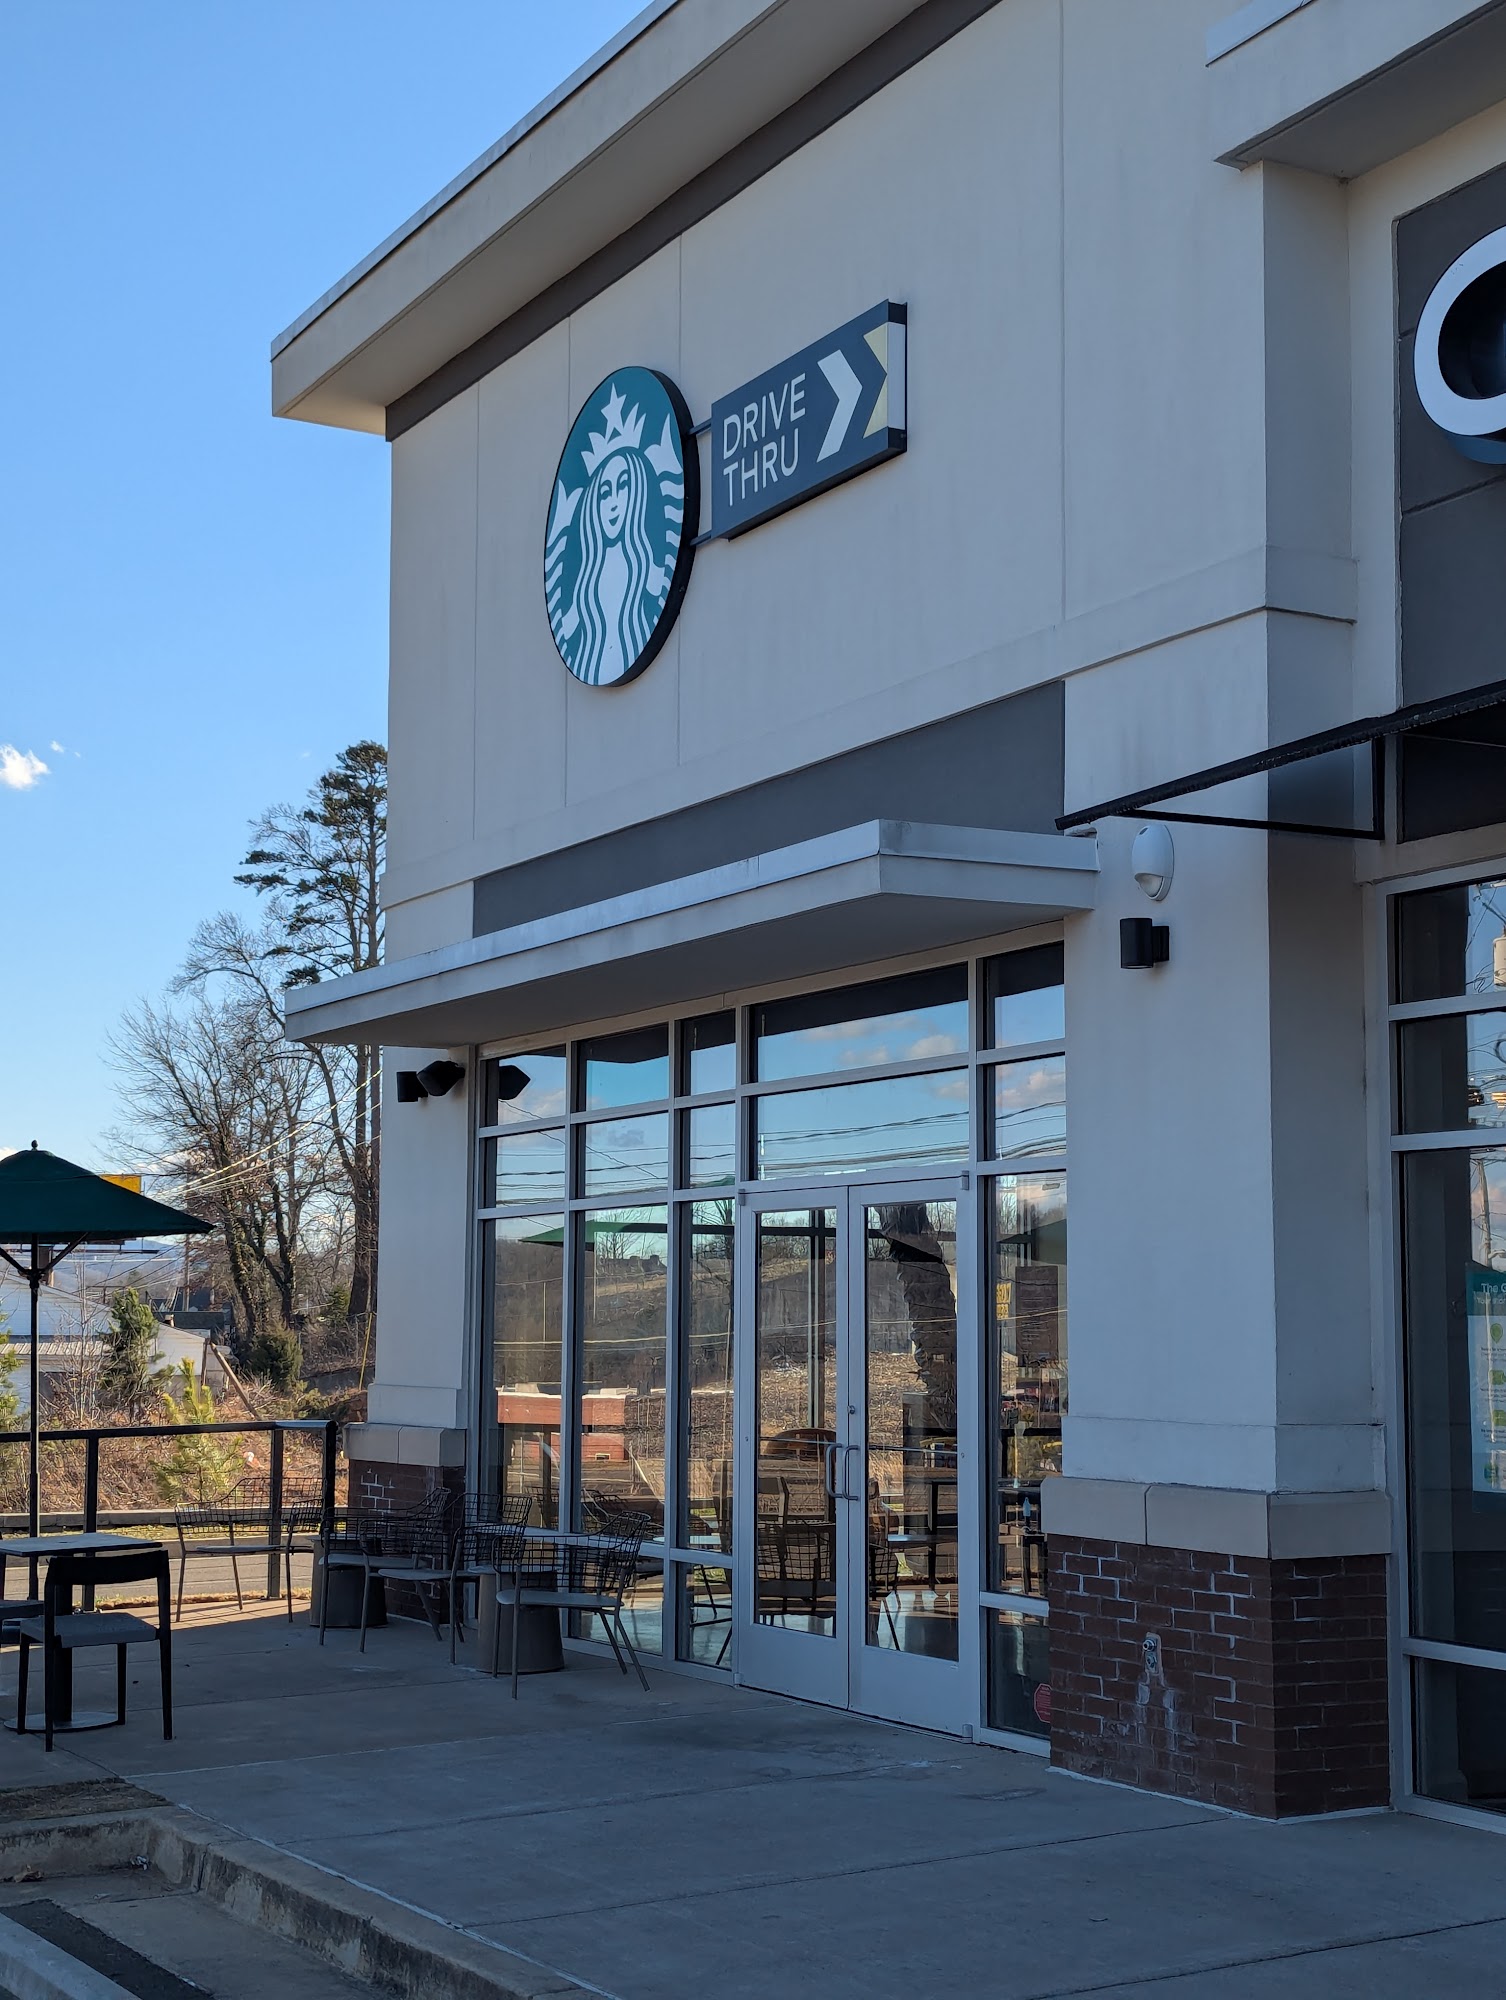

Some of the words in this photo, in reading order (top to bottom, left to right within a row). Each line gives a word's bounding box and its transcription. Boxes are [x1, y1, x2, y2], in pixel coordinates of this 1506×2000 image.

[724, 373, 806, 459] DRIVE
[723, 428, 799, 507] THRU
[1480, 1282, 1499, 1293] The
